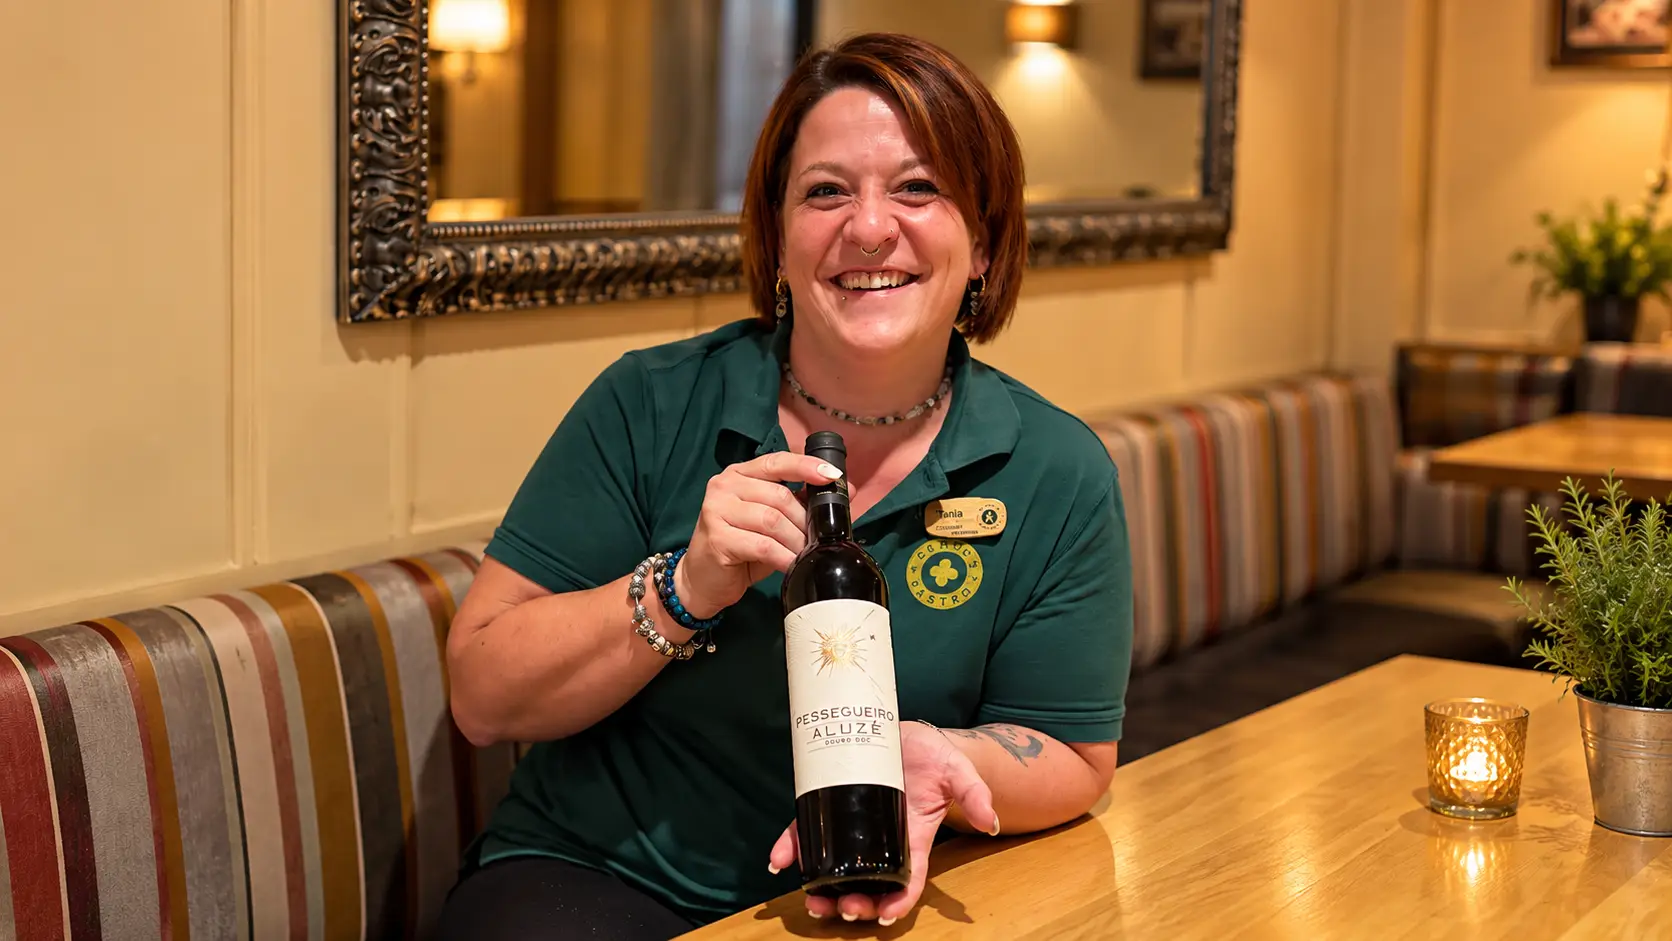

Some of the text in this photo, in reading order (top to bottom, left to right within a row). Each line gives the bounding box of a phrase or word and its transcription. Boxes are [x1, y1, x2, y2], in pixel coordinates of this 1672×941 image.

[936, 509, 963, 518] Tania
[796, 706, 894, 728] PESSEGUEIRO
[813, 720, 882, 739] ALUZÉ
